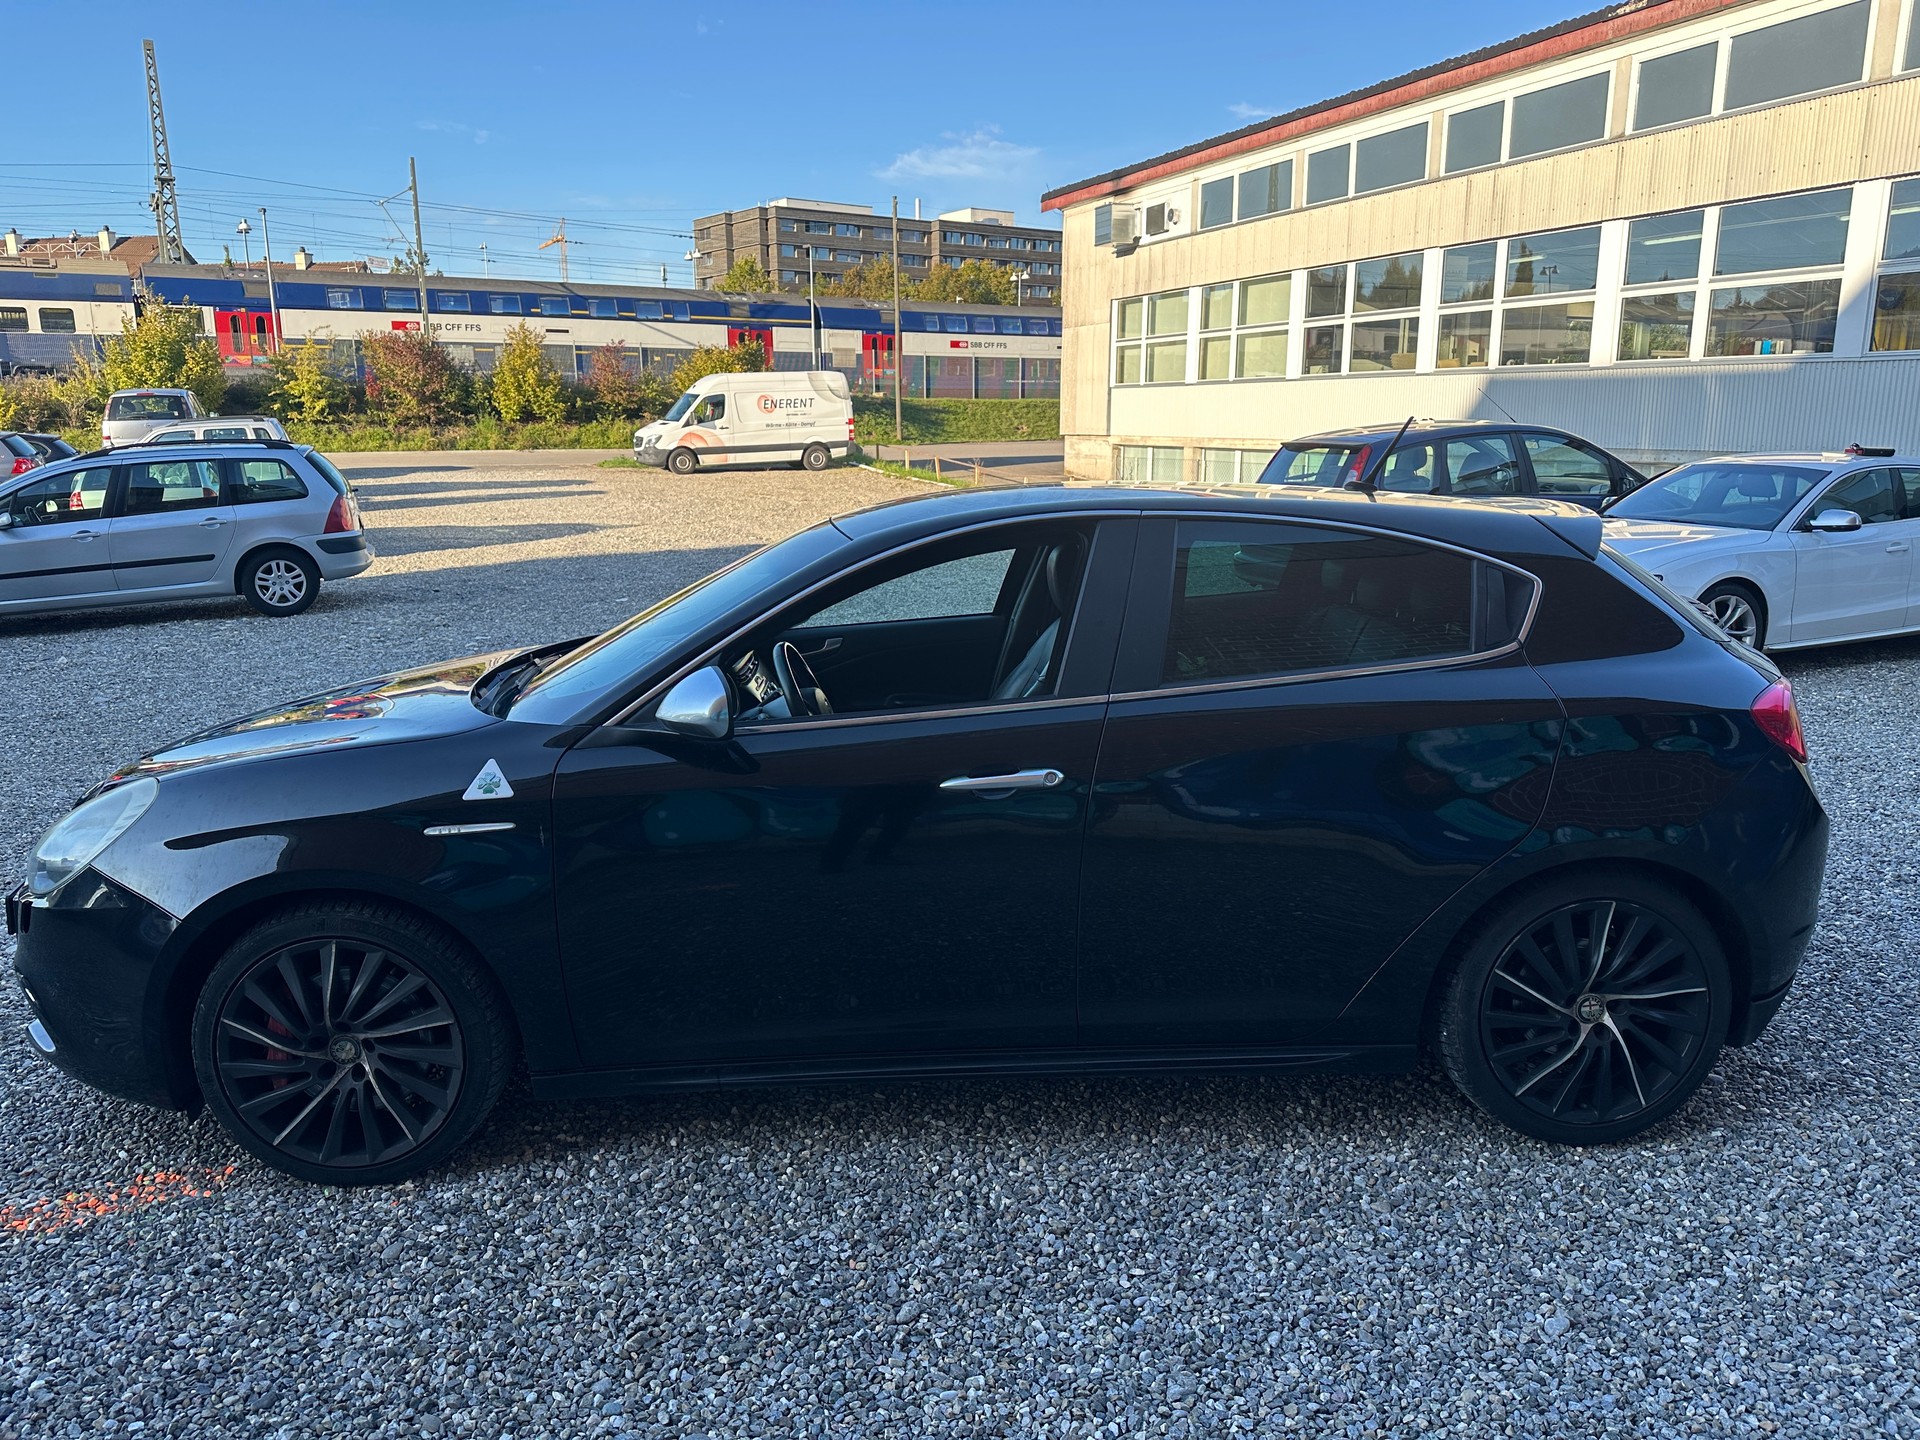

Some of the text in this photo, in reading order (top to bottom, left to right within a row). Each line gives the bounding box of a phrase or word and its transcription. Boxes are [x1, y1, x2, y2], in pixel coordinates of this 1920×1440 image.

[429, 322, 482, 332] BB CFF FFS
[764, 398, 815, 410] ENERENT
